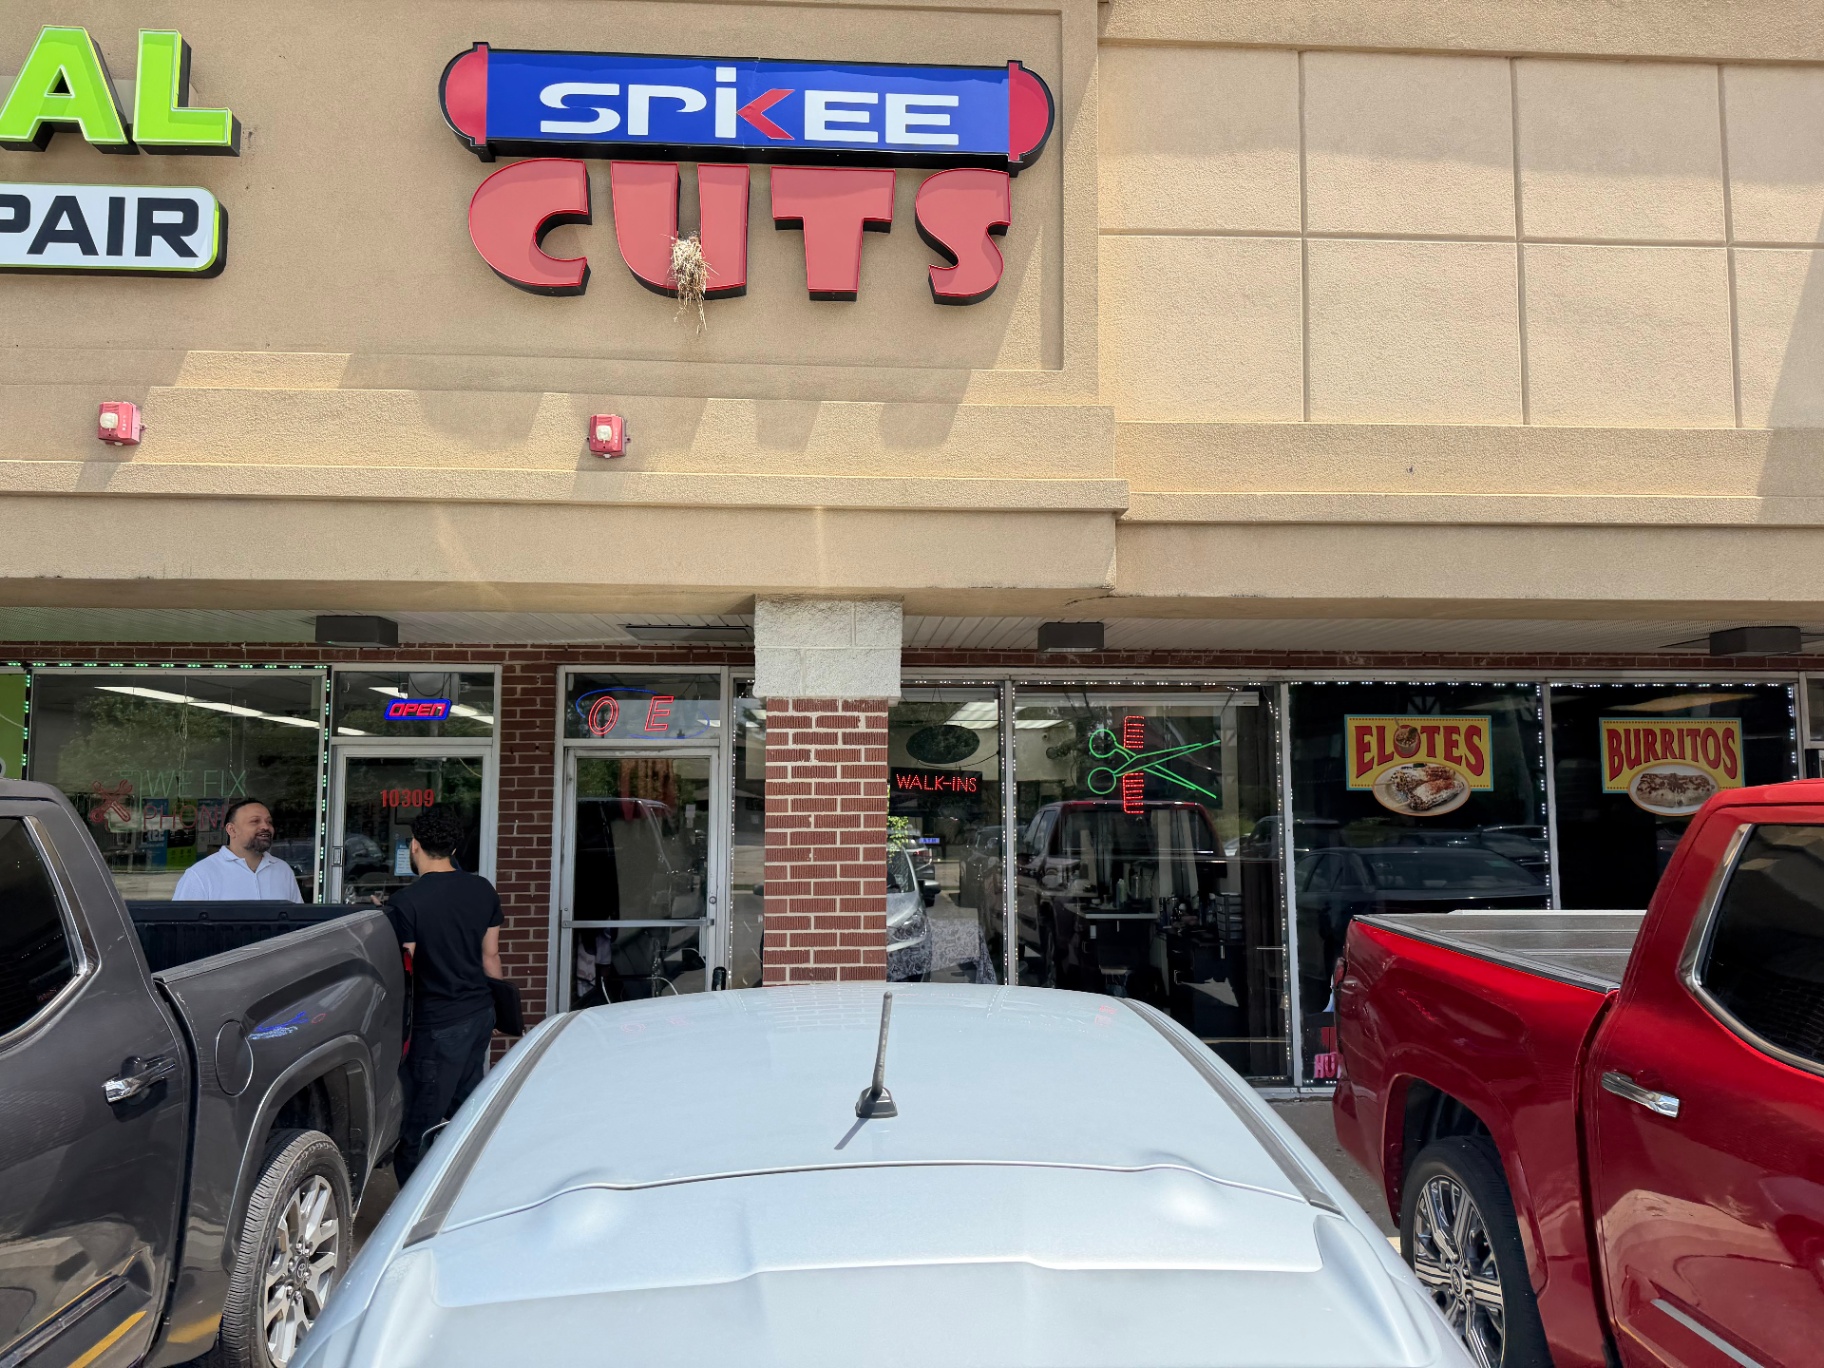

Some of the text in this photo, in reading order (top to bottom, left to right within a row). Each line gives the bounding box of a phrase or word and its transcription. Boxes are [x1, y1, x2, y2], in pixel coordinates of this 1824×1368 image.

[468, 157, 1012, 300] CUTS
[388, 702, 447, 717] OPEN
[1354, 724, 1485, 779] ELOTES
[1606, 727, 1738, 782] BURRITOS
[146, 769, 248, 798] WE FIX
[896, 773, 977, 793] WALK-INS
[381, 788, 435, 808] 10309
[1314, 1051, 1342, 1079] HU
